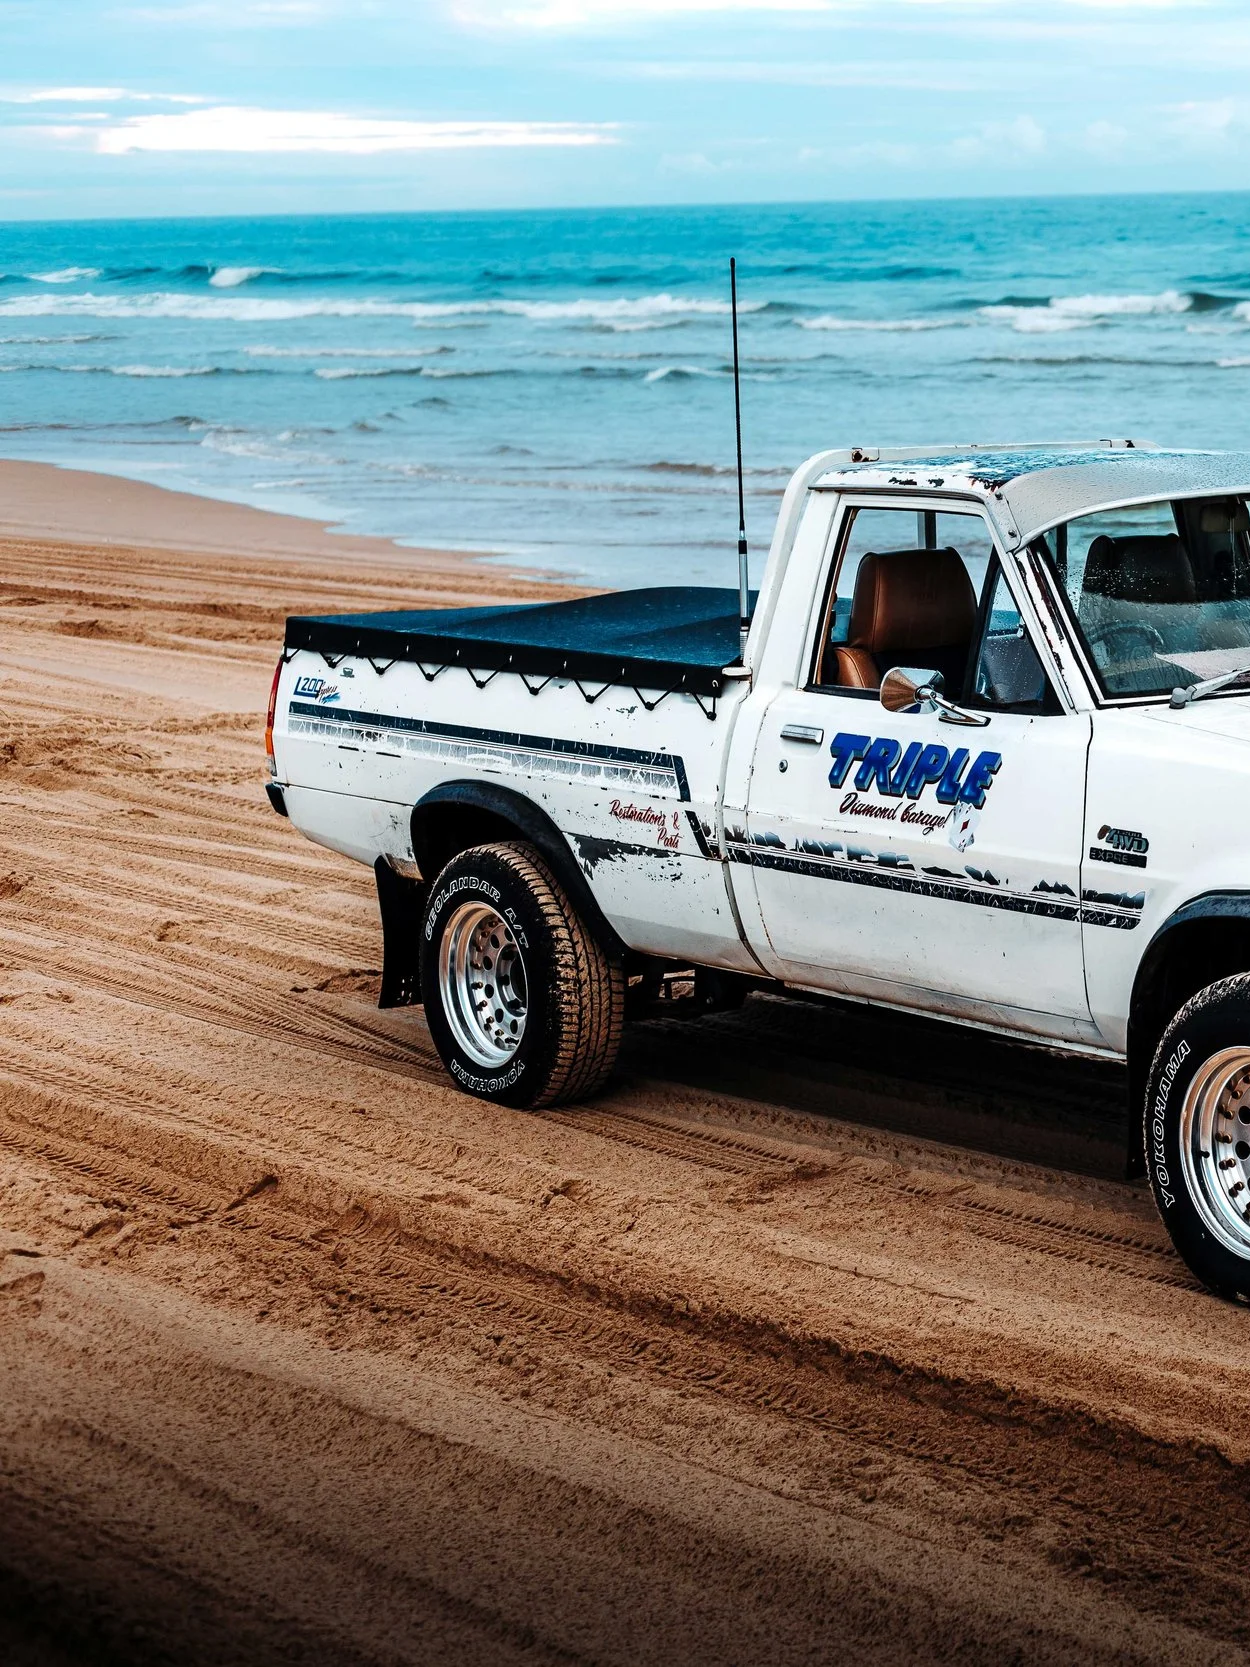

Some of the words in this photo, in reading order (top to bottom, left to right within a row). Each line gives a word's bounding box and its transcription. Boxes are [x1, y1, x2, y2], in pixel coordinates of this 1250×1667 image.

[293, 676, 324, 698] L200
[828, 732, 1002, 809] TRIPLE
[673, 811, 680, 830] &
[839, 792, 903, 821] Diamond
[657, 827, 683, 849] Parts
[1105, 829, 1149, 854] 4WD
[425, 876, 500, 940] GEOLANDAR
[504, 907, 529, 948] A/T
[450, 1059, 526, 1092] YOKOHAMA
[1149, 1040, 1191, 1208] YOKOHAMA
